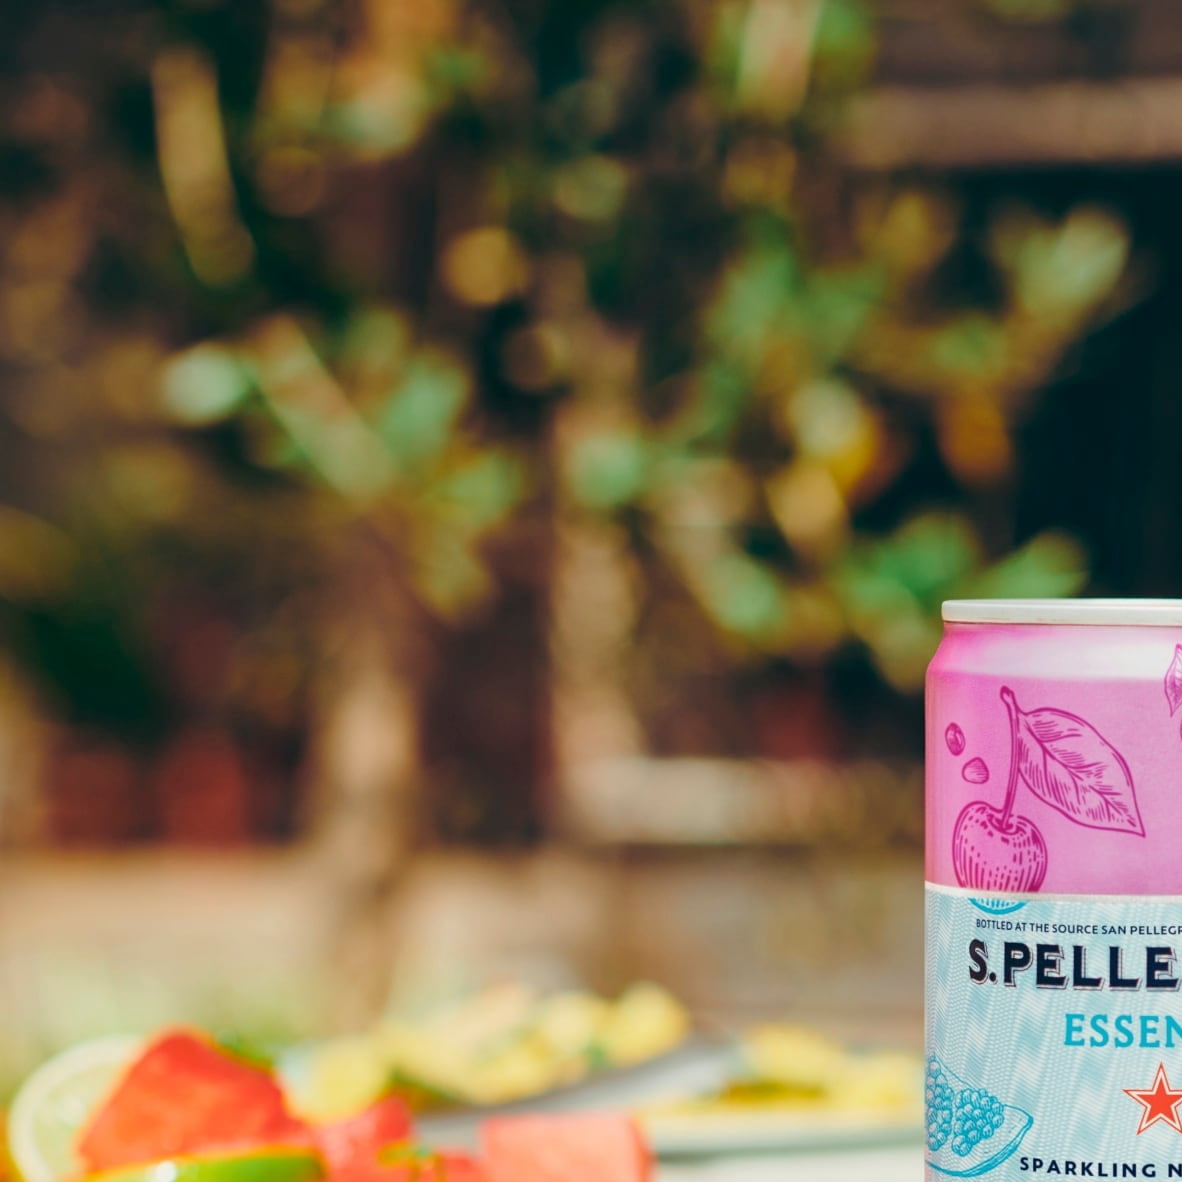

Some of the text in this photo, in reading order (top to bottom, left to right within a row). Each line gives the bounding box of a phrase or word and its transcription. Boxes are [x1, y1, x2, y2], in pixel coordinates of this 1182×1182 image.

[976, 919, 1012, 931] BOTTLED
[1015, 922, 1028, 932] AT
[1030, 923, 1049, 933] THE
[1052, 924, 1099, 934] SOURCE
[1101, 925, 1127, 935] SAN
[1020, 1156, 1156, 1178] SPARKLING
